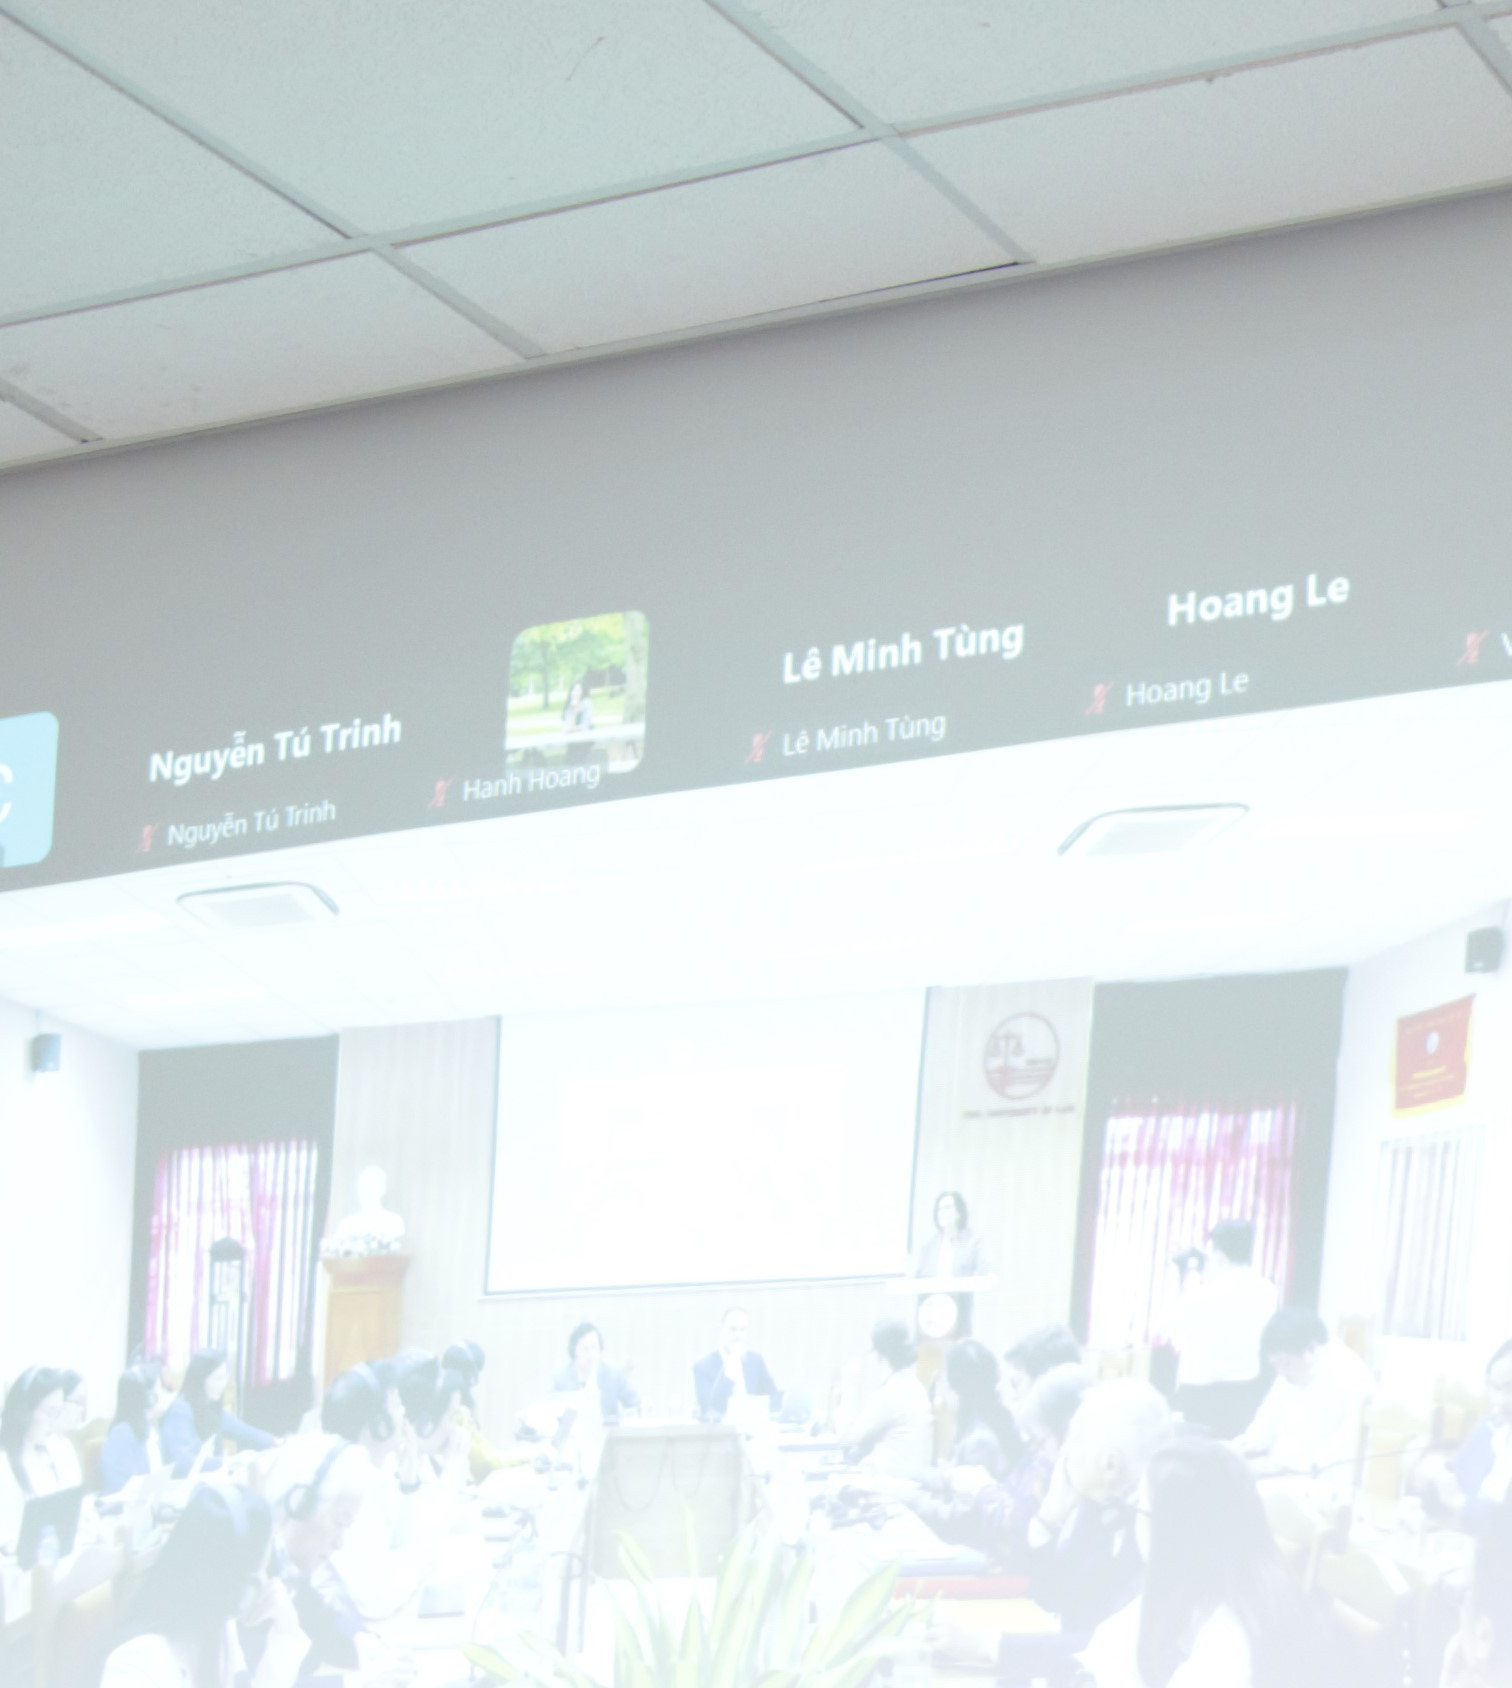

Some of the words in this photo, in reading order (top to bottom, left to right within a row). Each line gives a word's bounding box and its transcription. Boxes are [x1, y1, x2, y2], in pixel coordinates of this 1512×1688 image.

[1167, 584, 1294, 626] Hoang
[1306, 573, 1351, 607] Le
[782, 646, 822, 684] Lê
[830, 632, 922, 677] Minh
[932, 622, 1025, 661] Tùng
[1125, 677, 1212, 706] Hoang
[1219, 671, 1250, 695] Le
[148, 730, 265, 786] Nguyễn
[273, 727, 312, 761] Tú
[320, 712, 402, 753] Trinh
[782, 729, 810, 756] Lê
[816, 719, 878, 751] Minh
[885, 713, 946, 741] Tùng
[527, 763, 601, 795] Hoang
[167, 812, 248, 849] Nguyễn
[254, 808, 279, 834] Tú
[284, 800, 337, 829] Trinh
